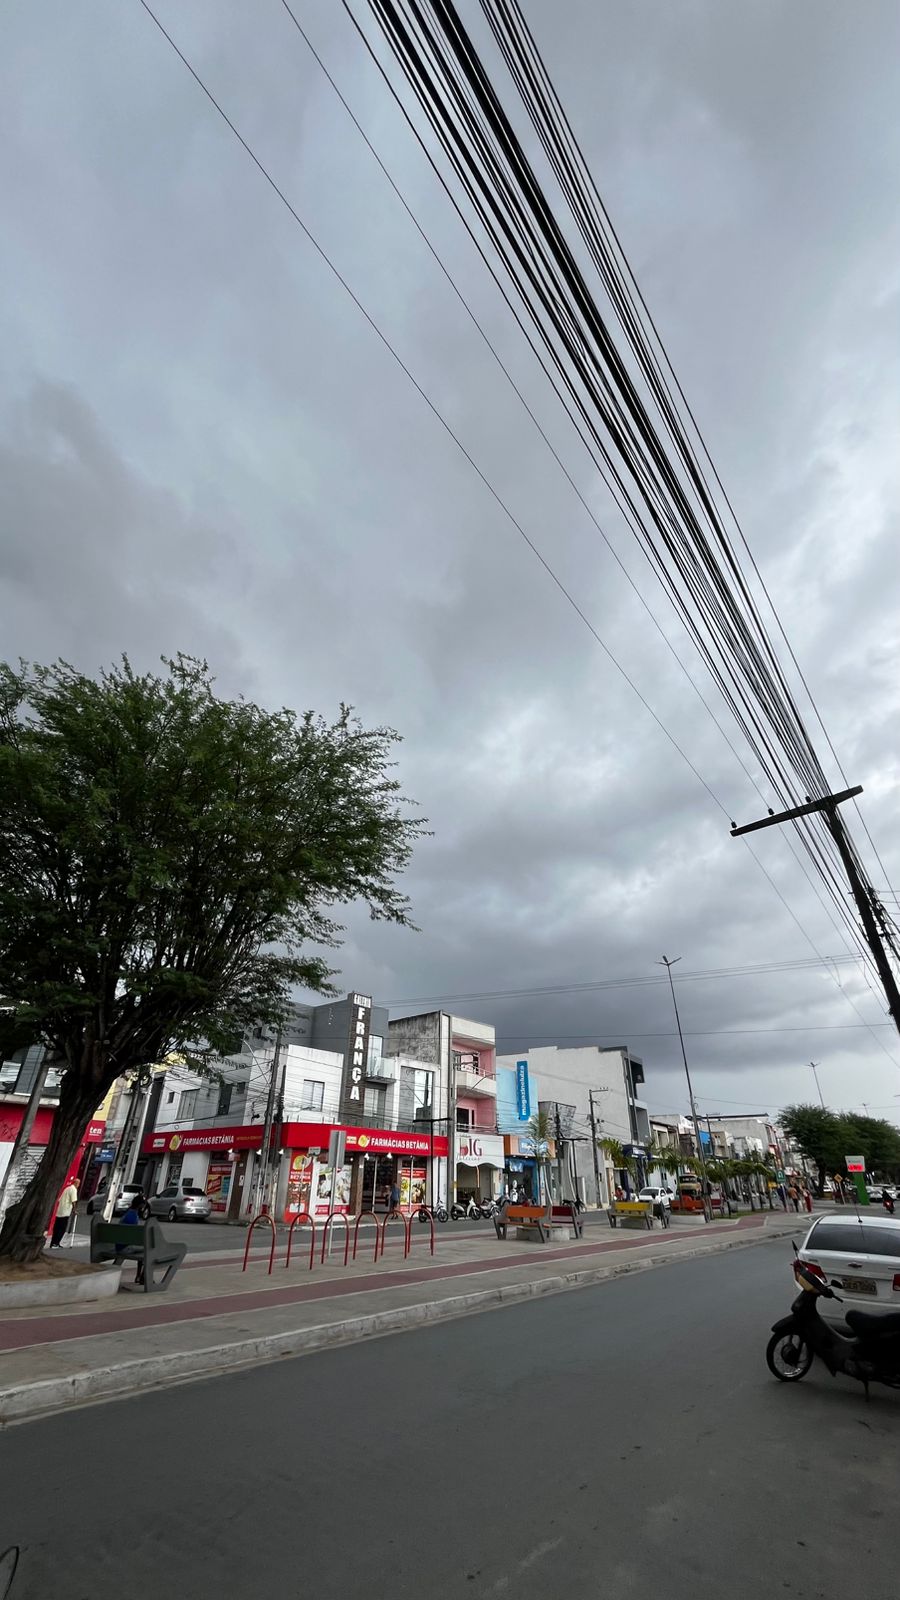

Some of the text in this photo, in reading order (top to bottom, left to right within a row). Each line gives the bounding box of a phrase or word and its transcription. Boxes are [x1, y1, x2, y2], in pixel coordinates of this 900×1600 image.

[350, 1007, 365, 1100] FRANÇA
[183, 1134, 234, 1146] FARMÁCIAS BETÂNIA
[370, 1137, 405, 1149] FARMÁCIAS
[406, 1139, 429, 1150] BETÂNIA
